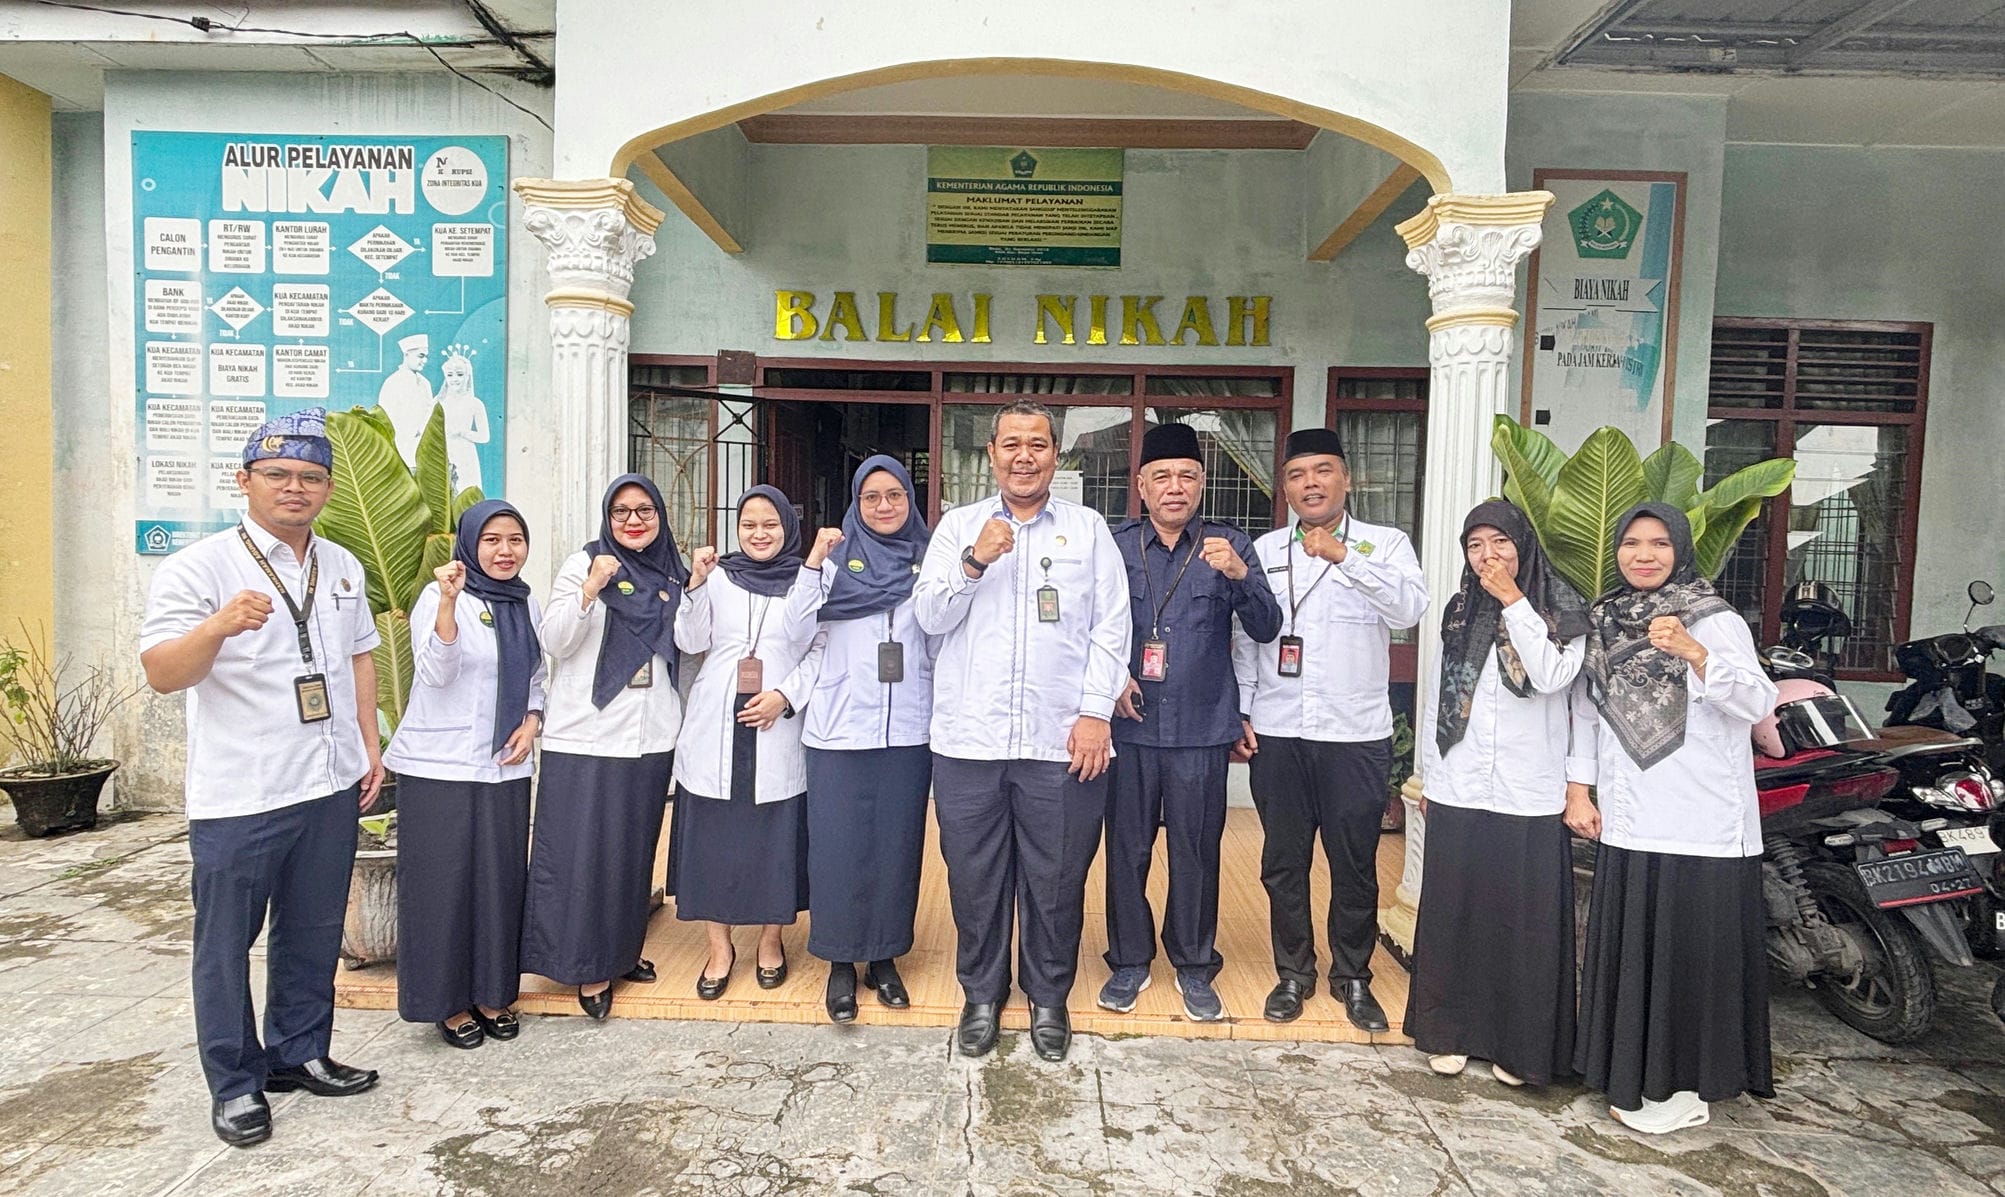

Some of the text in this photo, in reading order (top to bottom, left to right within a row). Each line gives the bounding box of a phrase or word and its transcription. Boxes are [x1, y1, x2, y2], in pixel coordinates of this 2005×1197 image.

[224, 145, 412, 169] ALUR PELAYANAN
[441, 179, 470, 187] INTEGRITAS
[937, 182, 993, 190] KEMENTERIAN
[995, 183, 1026, 191] AGAMA
[1028, 184, 1066, 192] REPUBLIK
[222, 166, 415, 214] NIKAH
[967, 196, 1022, 204] MAKLUMAT
[223, 224, 250, 232] RT/RW
[275, 225, 327, 233] KANTOR LURAH
[435, 227, 446, 235] KUA
[460, 227, 491, 235] SETEMPAT
[160, 233, 186, 242] CALON
[151, 246, 195, 256] PENGANTIN
[162, 288, 184, 297] BANK
[1574, 279, 1630, 301] BIAYA NIKAH
[774, 290, 1273, 347] BALAI NIKAH
[147, 346, 200, 355] KUA KECAMATAN
[211, 349, 264, 357] KUA KECAMATAN
[276, 349, 327, 357] KANTOR CAMAT
[1557, 352, 1577, 367] PADA
[1578, 353, 1594, 367] JAM
[1596, 353, 1620, 368] KERJA
[148, 404, 160, 412] KUA
[211, 406, 264, 414] KUA KECAMATAN
